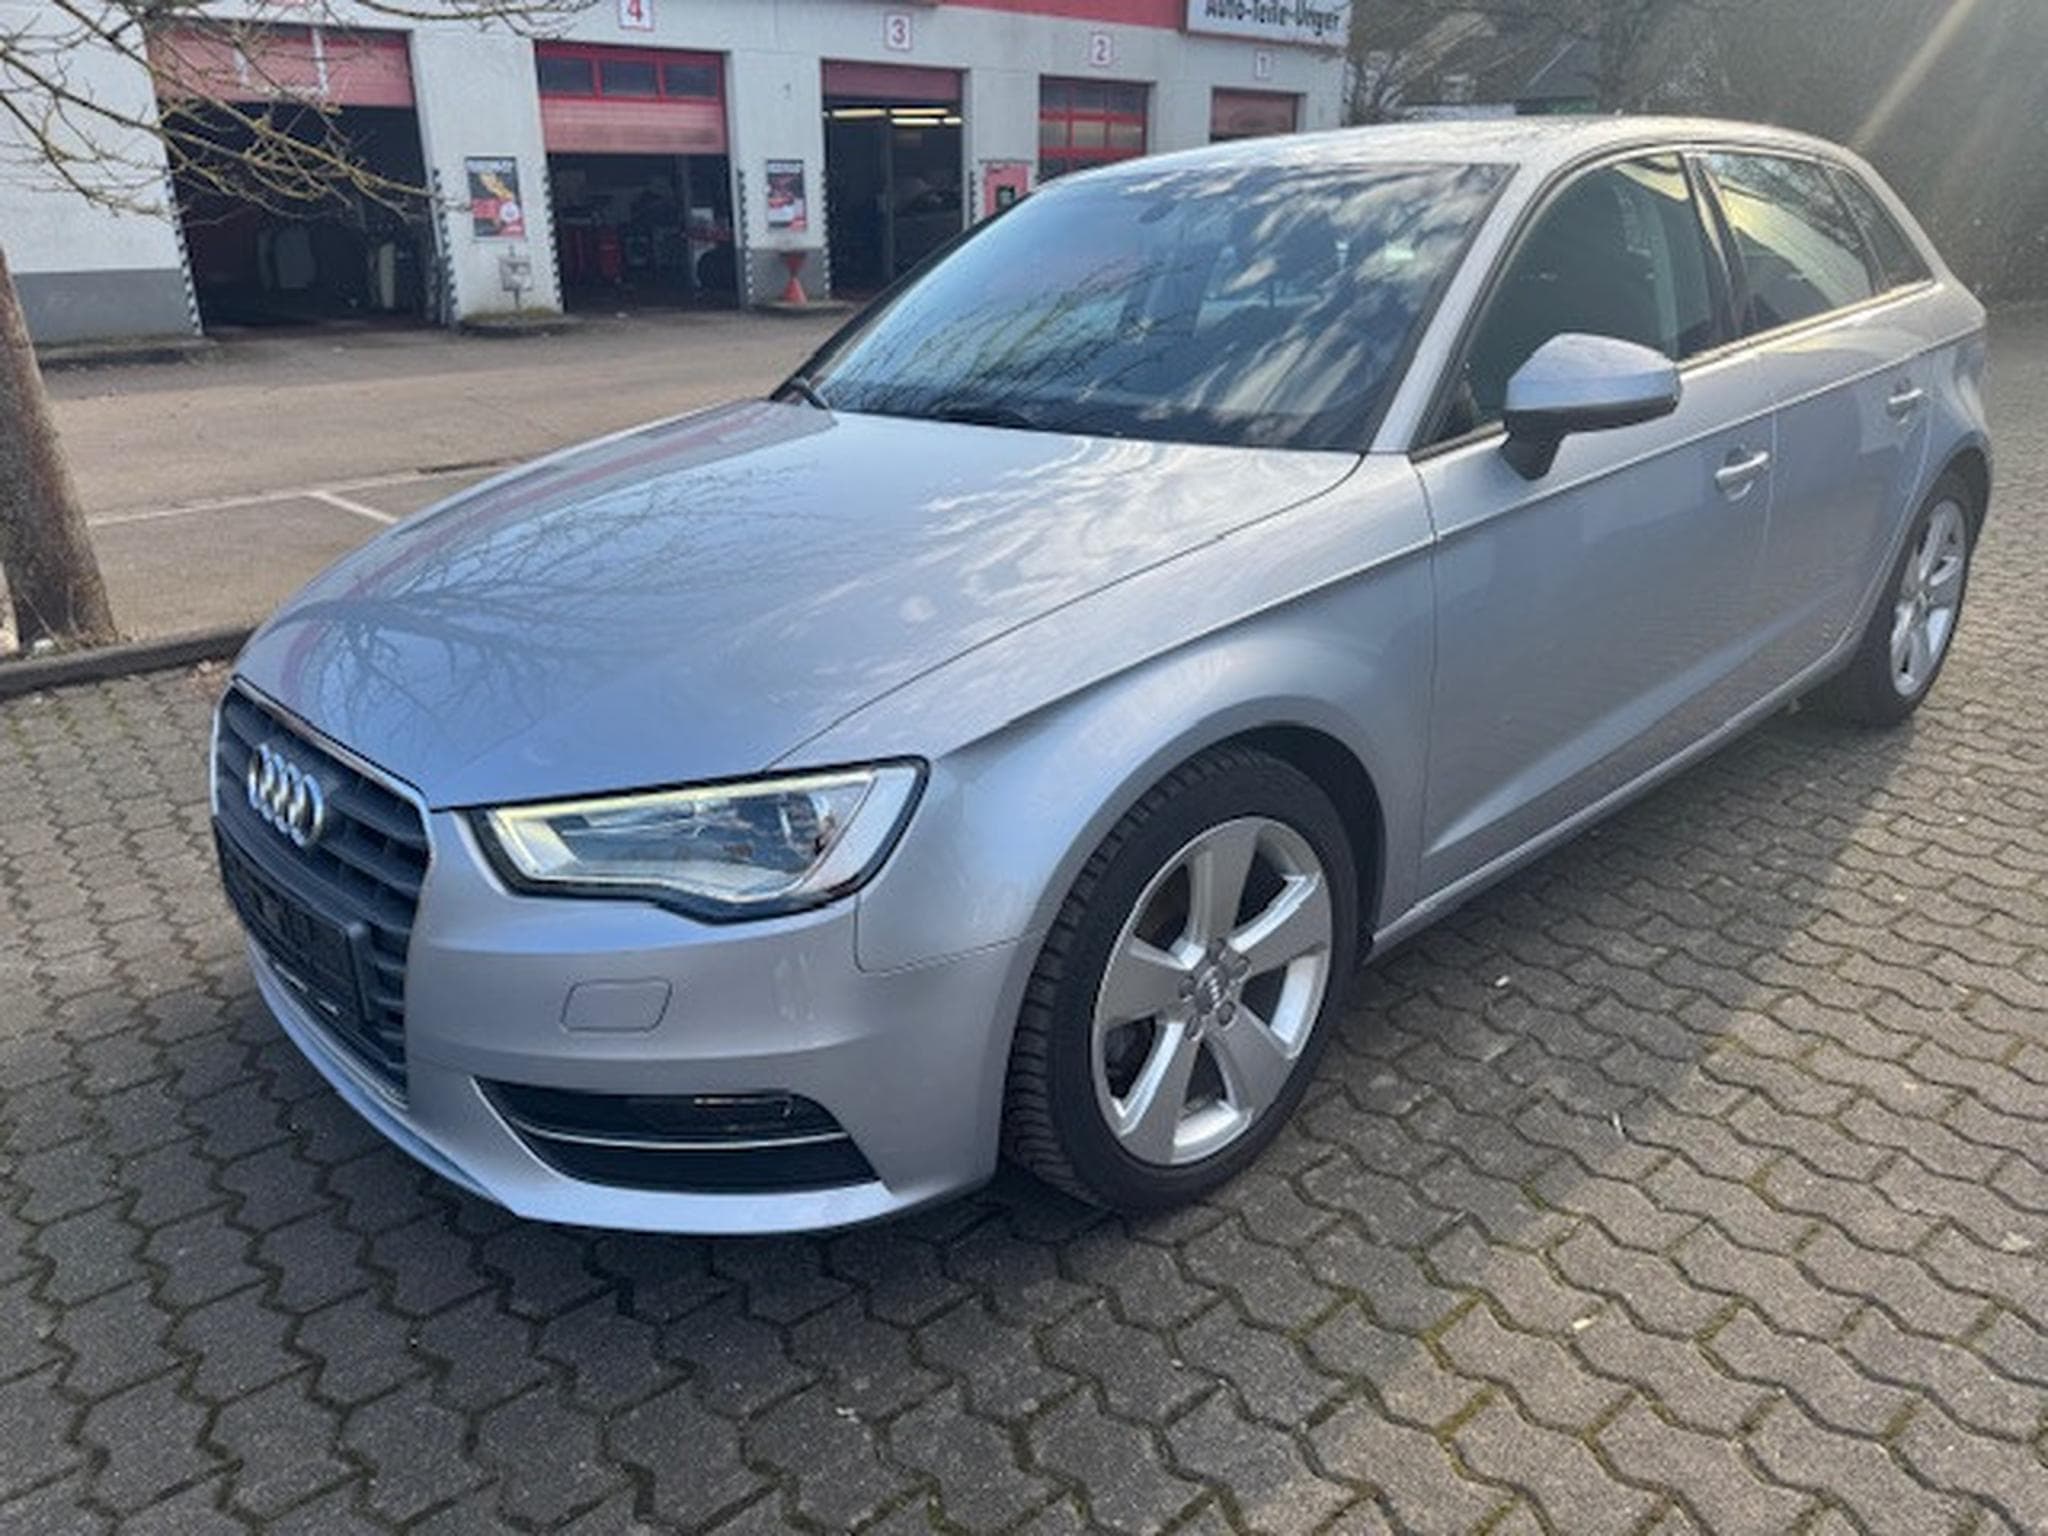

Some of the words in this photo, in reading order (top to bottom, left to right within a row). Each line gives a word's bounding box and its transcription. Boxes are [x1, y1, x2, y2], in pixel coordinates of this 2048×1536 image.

[626, 0, 644, 21] 4
[1204, 0, 1340, 36] Auto-Teile-Unger
[891, 18, 906, 45] 3
[1096, 38, 1108, 62] 2
